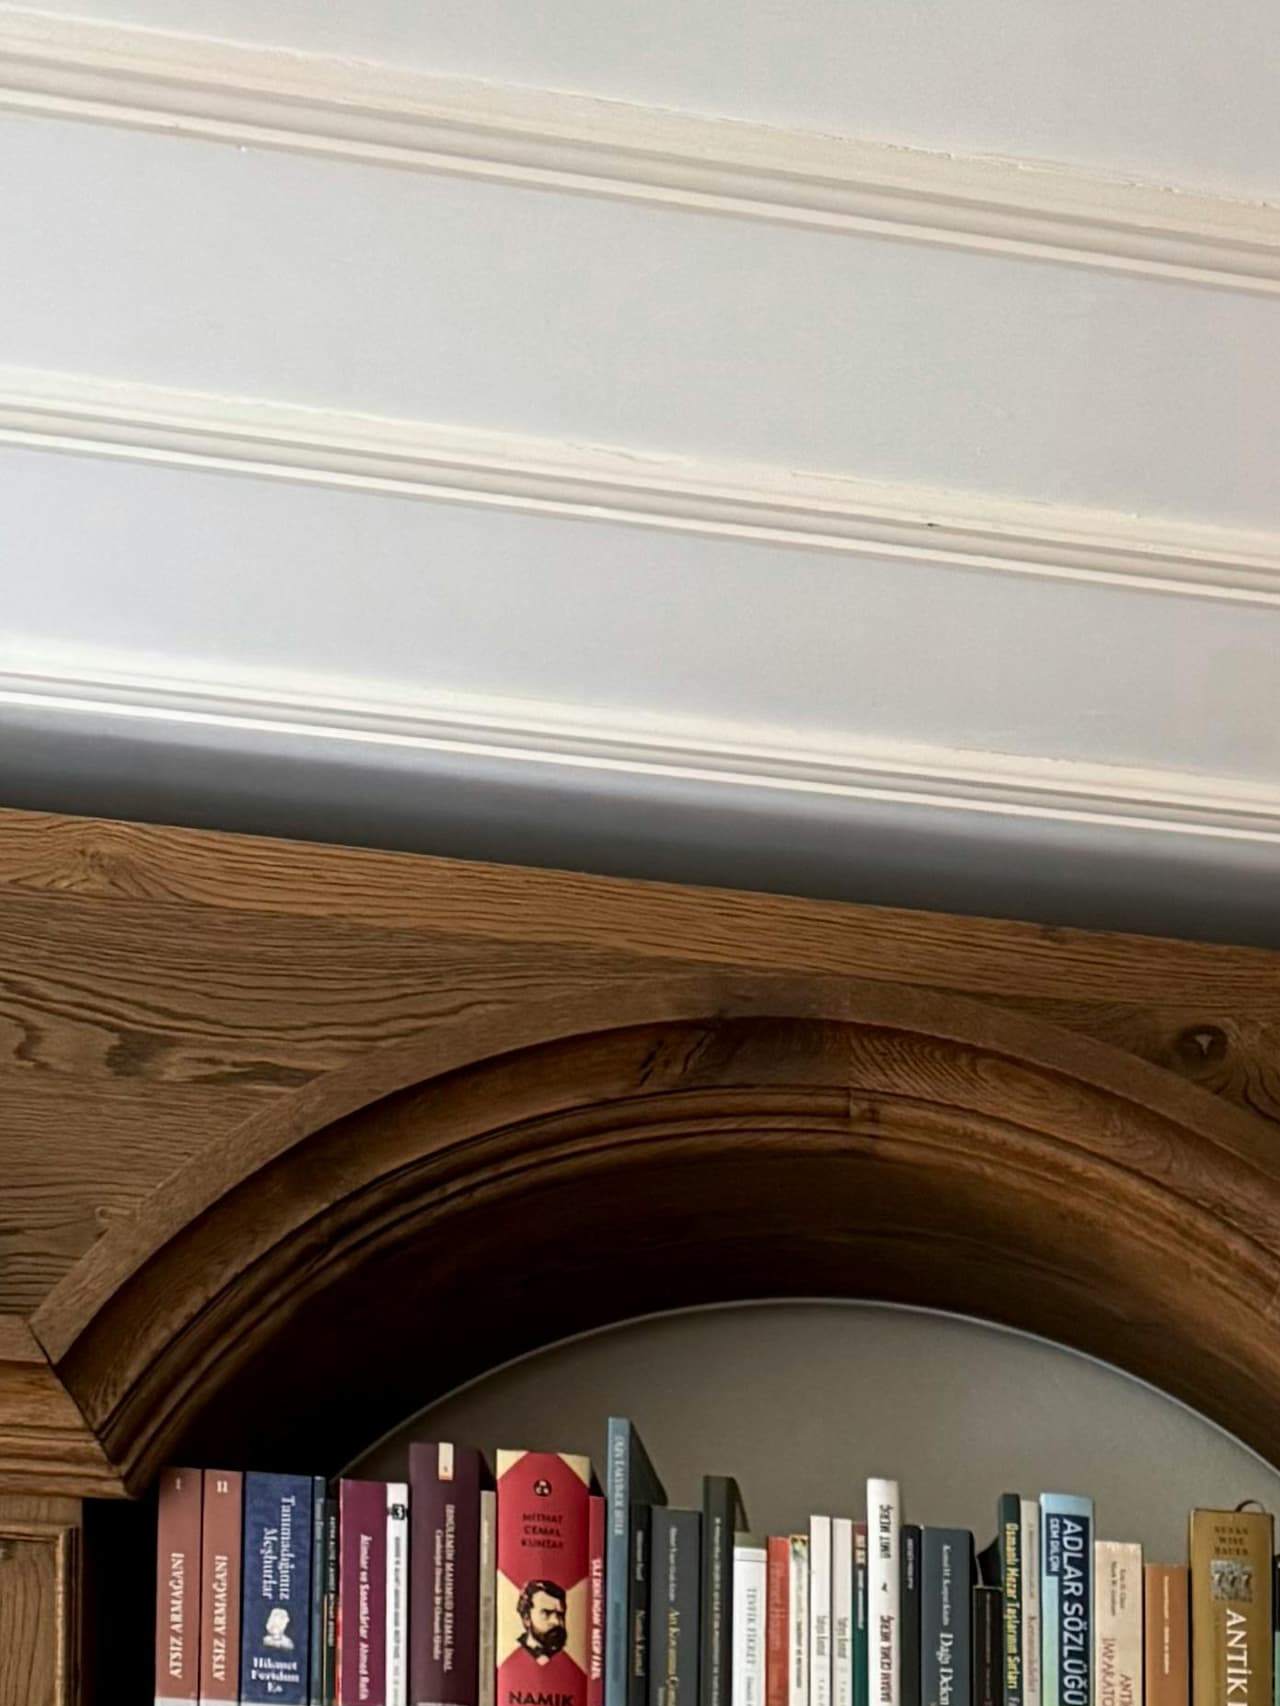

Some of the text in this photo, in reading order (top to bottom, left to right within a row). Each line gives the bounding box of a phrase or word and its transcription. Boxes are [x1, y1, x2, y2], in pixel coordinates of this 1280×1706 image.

[1048, 1518, 1060, 1576] CEM DİLÇİN
[168, 1550, 185, 1680] ATSIZ ARMAĞANI
[211, 1554, 228, 1682] ATSIZ ARMAĞANI
[1061, 1518, 1089, 1706] ADLAR SÖZLÜĞÜ
